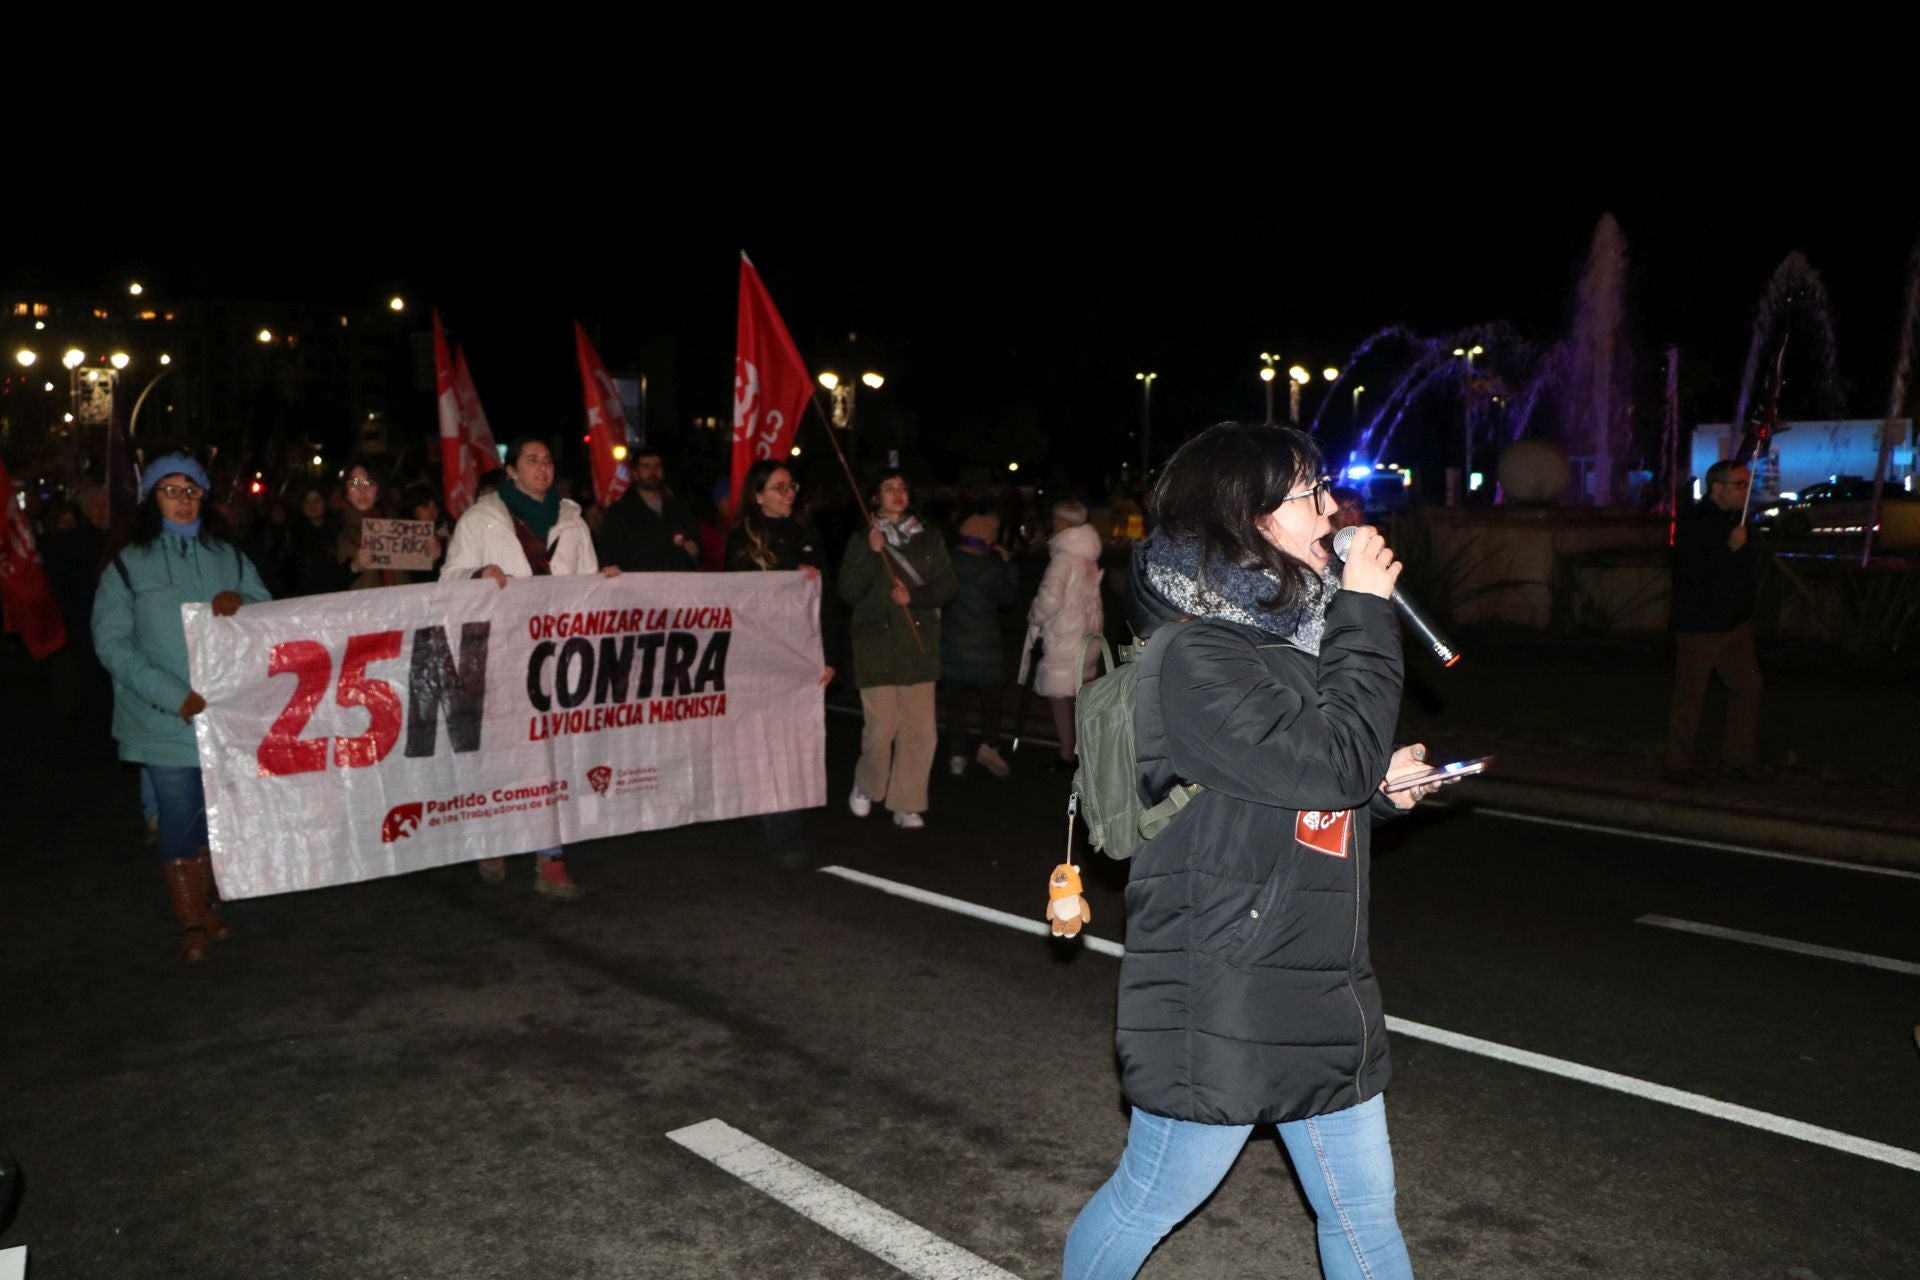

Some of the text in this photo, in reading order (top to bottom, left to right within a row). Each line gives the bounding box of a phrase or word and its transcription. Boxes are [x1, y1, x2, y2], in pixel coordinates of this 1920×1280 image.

[365, 520, 432, 536] NO SOMOS
[529, 607, 732, 640] ORGANIZAR LA LUCHA
[527, 631, 731, 712] CONTRA
[257, 620, 490, 778] 25N
[551, 703, 643, 736] VIOLENCIA
[648, 694, 726, 724] MACHISTA
[427, 792, 487, 814] Partido
